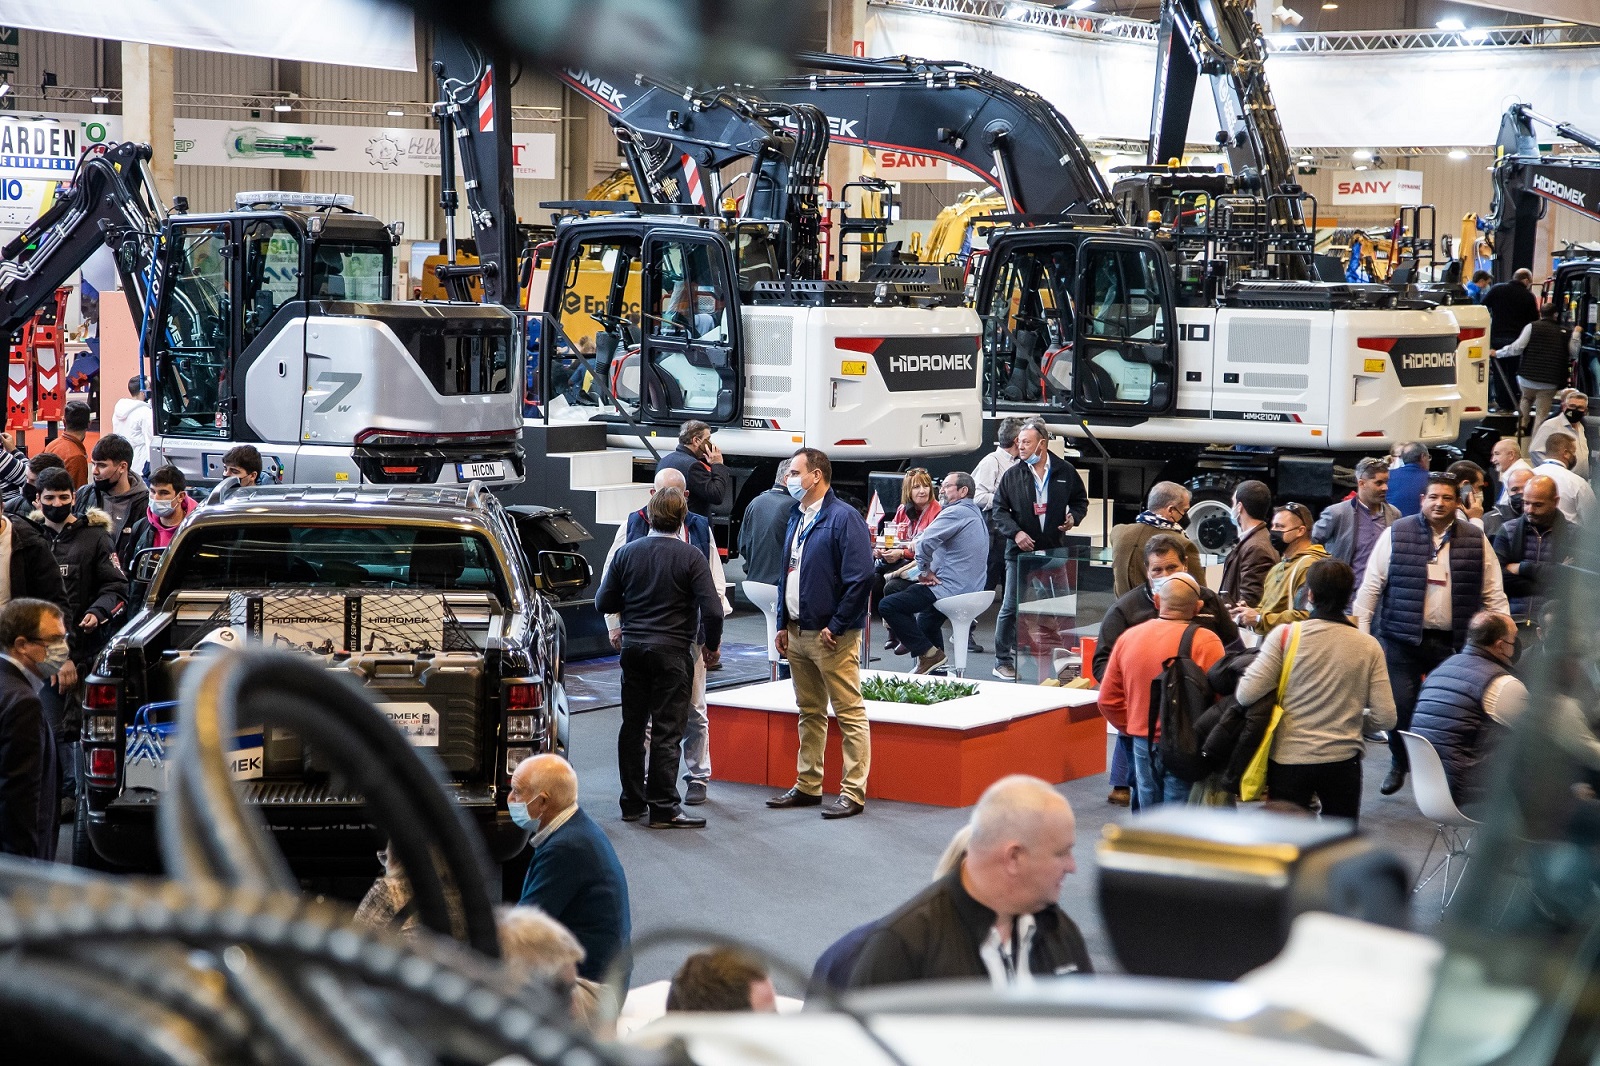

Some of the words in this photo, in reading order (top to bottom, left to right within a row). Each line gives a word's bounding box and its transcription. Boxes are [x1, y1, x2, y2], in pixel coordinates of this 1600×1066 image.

[562, 67, 627, 110] OMEK
[1, 125, 76, 157] ARDEN
[0, 156, 75, 170] EQUIPMENT
[881, 152, 939, 168] SANY
[1338, 181, 1392, 195] SANY
[1243, 412, 1281, 421] HMK210W
[471, 463, 496, 478] HICON
